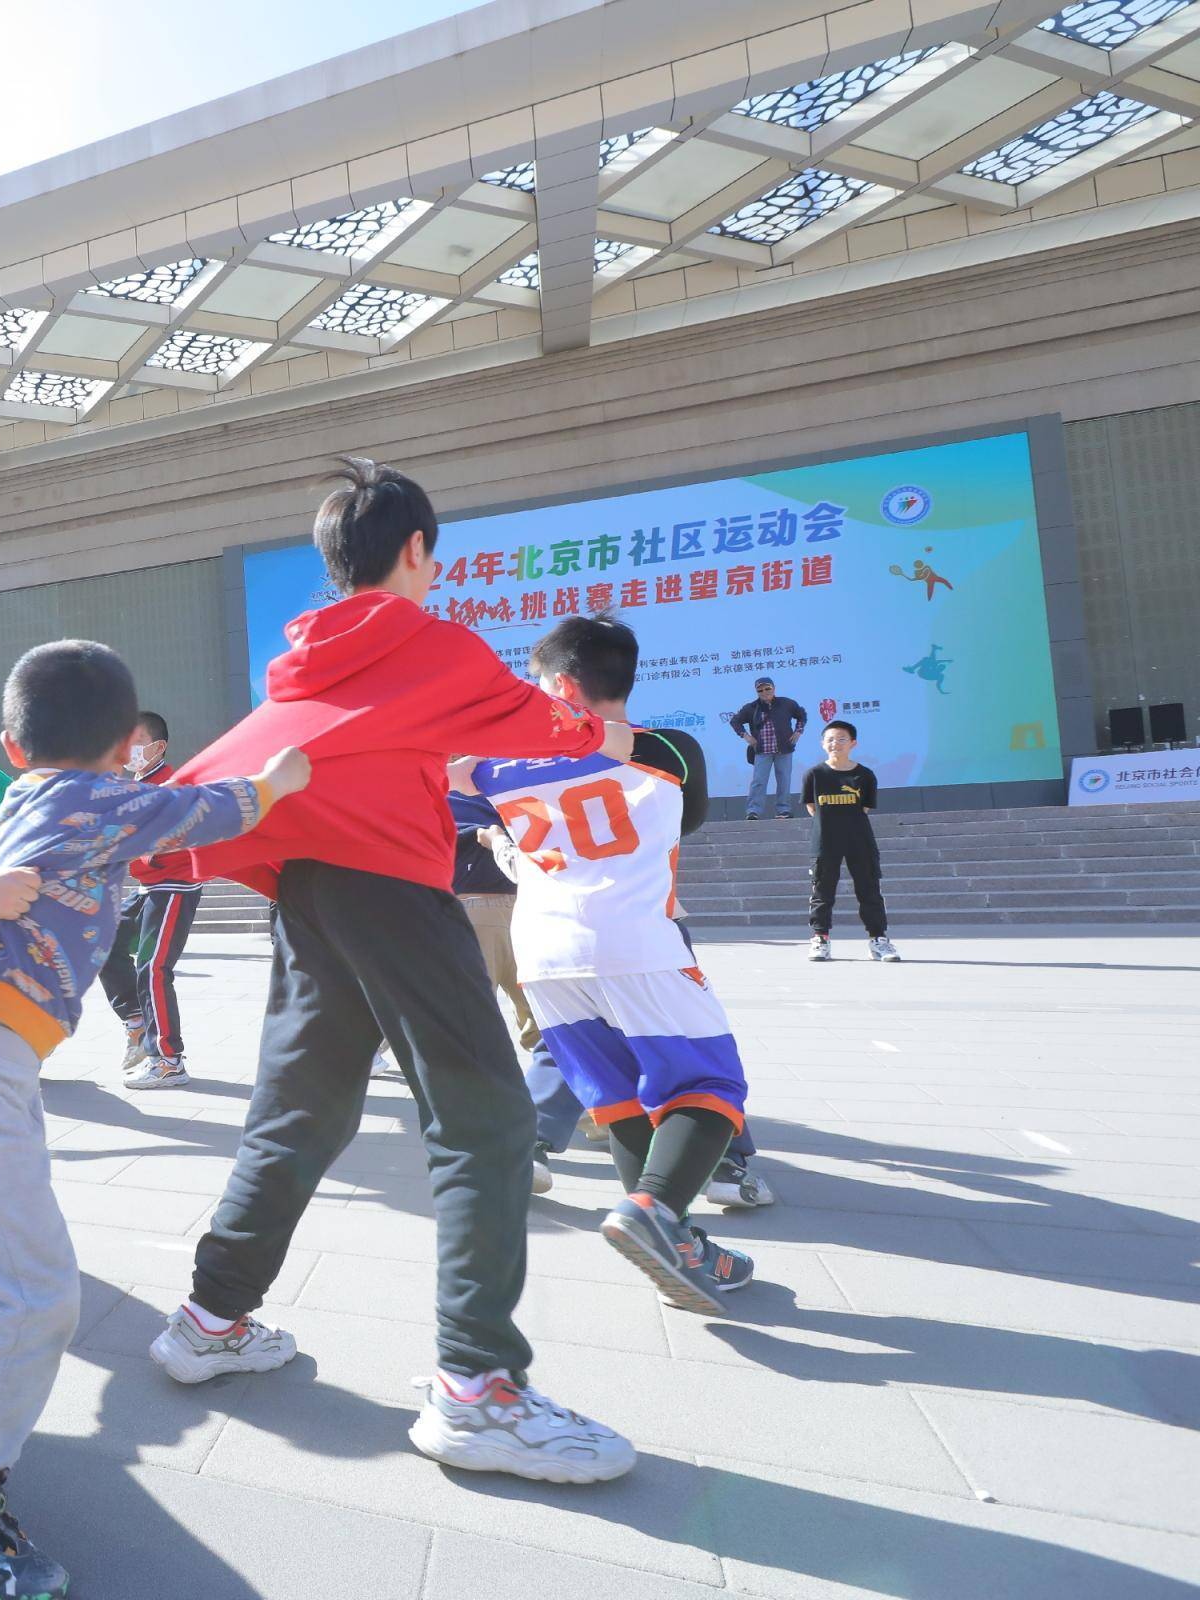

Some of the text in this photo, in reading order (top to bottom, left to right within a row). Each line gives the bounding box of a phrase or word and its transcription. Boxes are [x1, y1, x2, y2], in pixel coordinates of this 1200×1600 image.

[818, 794, 857, 806] PUMA
[496, 778, 640, 873] 20
[715, 1253, 734, 1279] N
